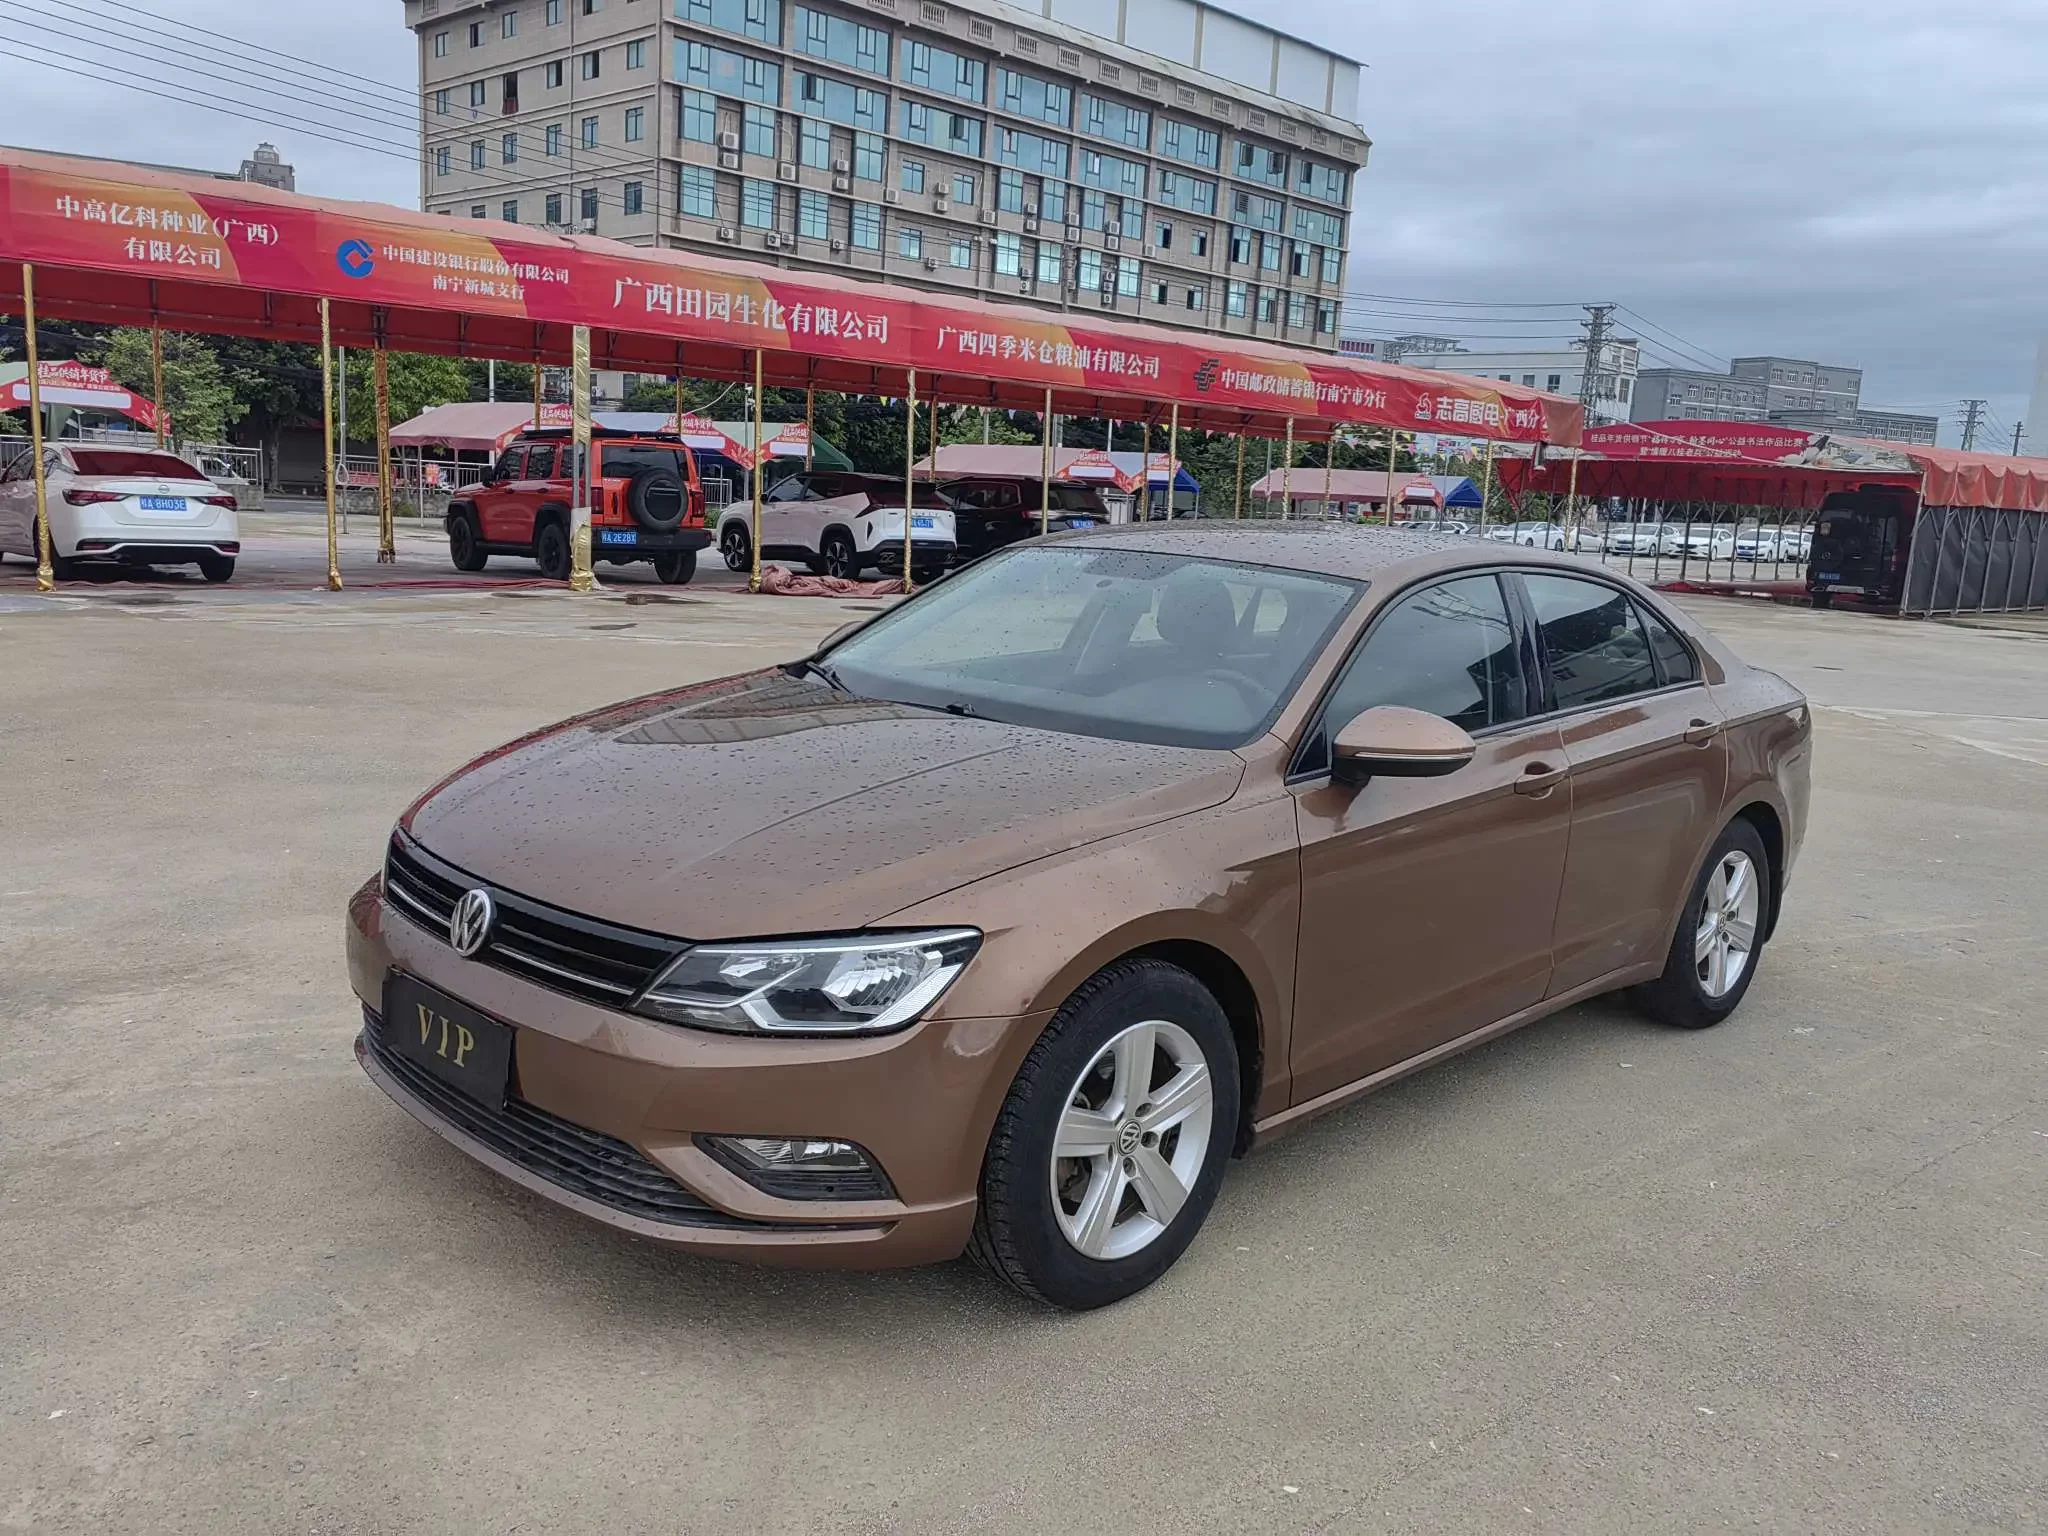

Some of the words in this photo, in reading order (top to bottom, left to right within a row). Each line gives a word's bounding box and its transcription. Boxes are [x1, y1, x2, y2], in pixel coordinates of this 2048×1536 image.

[123, 237, 221, 270] 有限公司
[383, 244, 569, 285] 中国建设银行股份有限公司
[432, 274, 526, 300] 南宁新城支行
[612, 277, 889, 344] 广西田园生化有限公司
[937, 326, 1161, 379] 广西四季米仓粮油有限公司
[1221, 367, 1386, 409] 中国邮政储蓄银行南宁市分行
[416, 1003, 475, 1068] VIP
